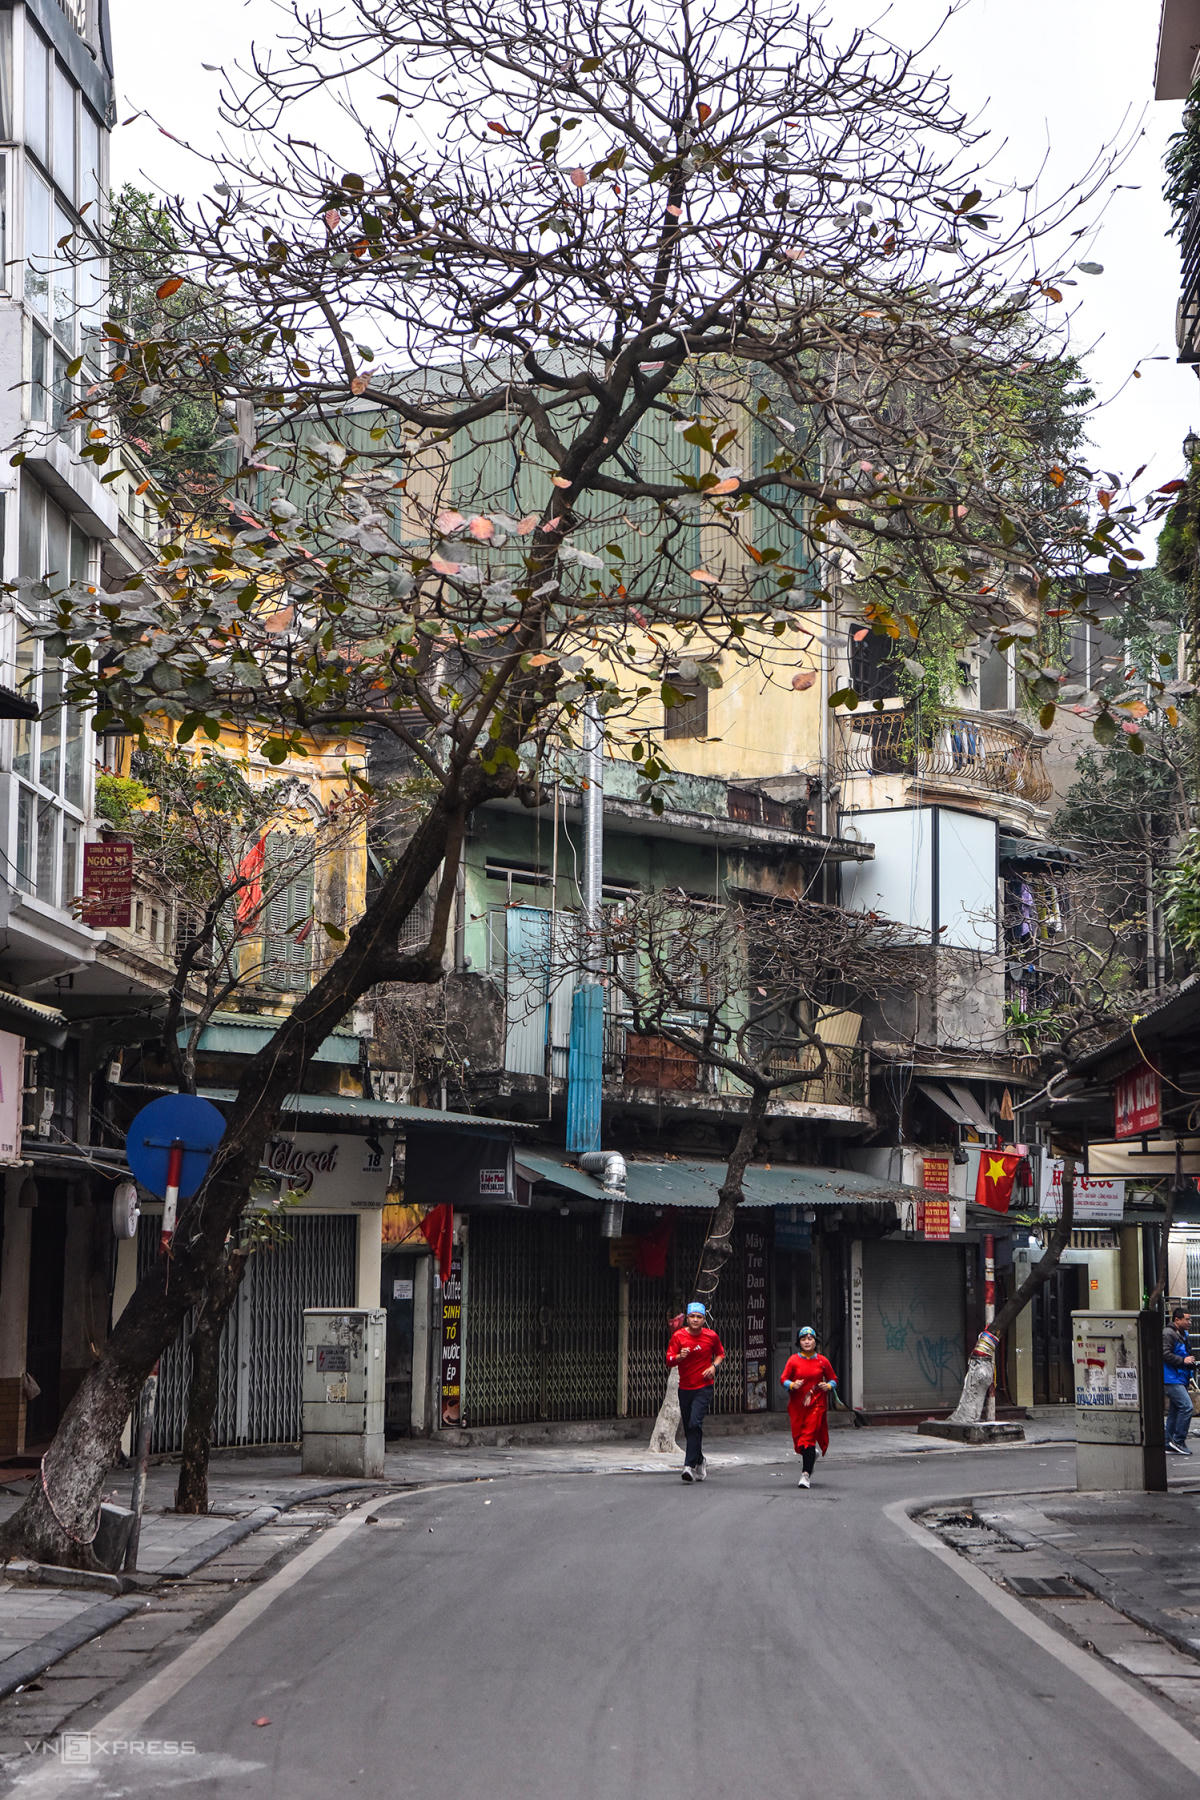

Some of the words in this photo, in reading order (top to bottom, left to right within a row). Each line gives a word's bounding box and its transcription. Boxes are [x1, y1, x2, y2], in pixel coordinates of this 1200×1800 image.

[367, 1153, 380, 1168] 18
[747, 1253, 763, 1268] Tre
[747, 1274, 765, 1288] Đan
[746, 1294, 765, 1309] Anh
[443, 1305, 461, 1319] SINH
[747, 1315, 765, 1330] Thư
[446, 1322, 457, 1340] TỐ
[442, 1342, 460, 1360] NƯỚC
